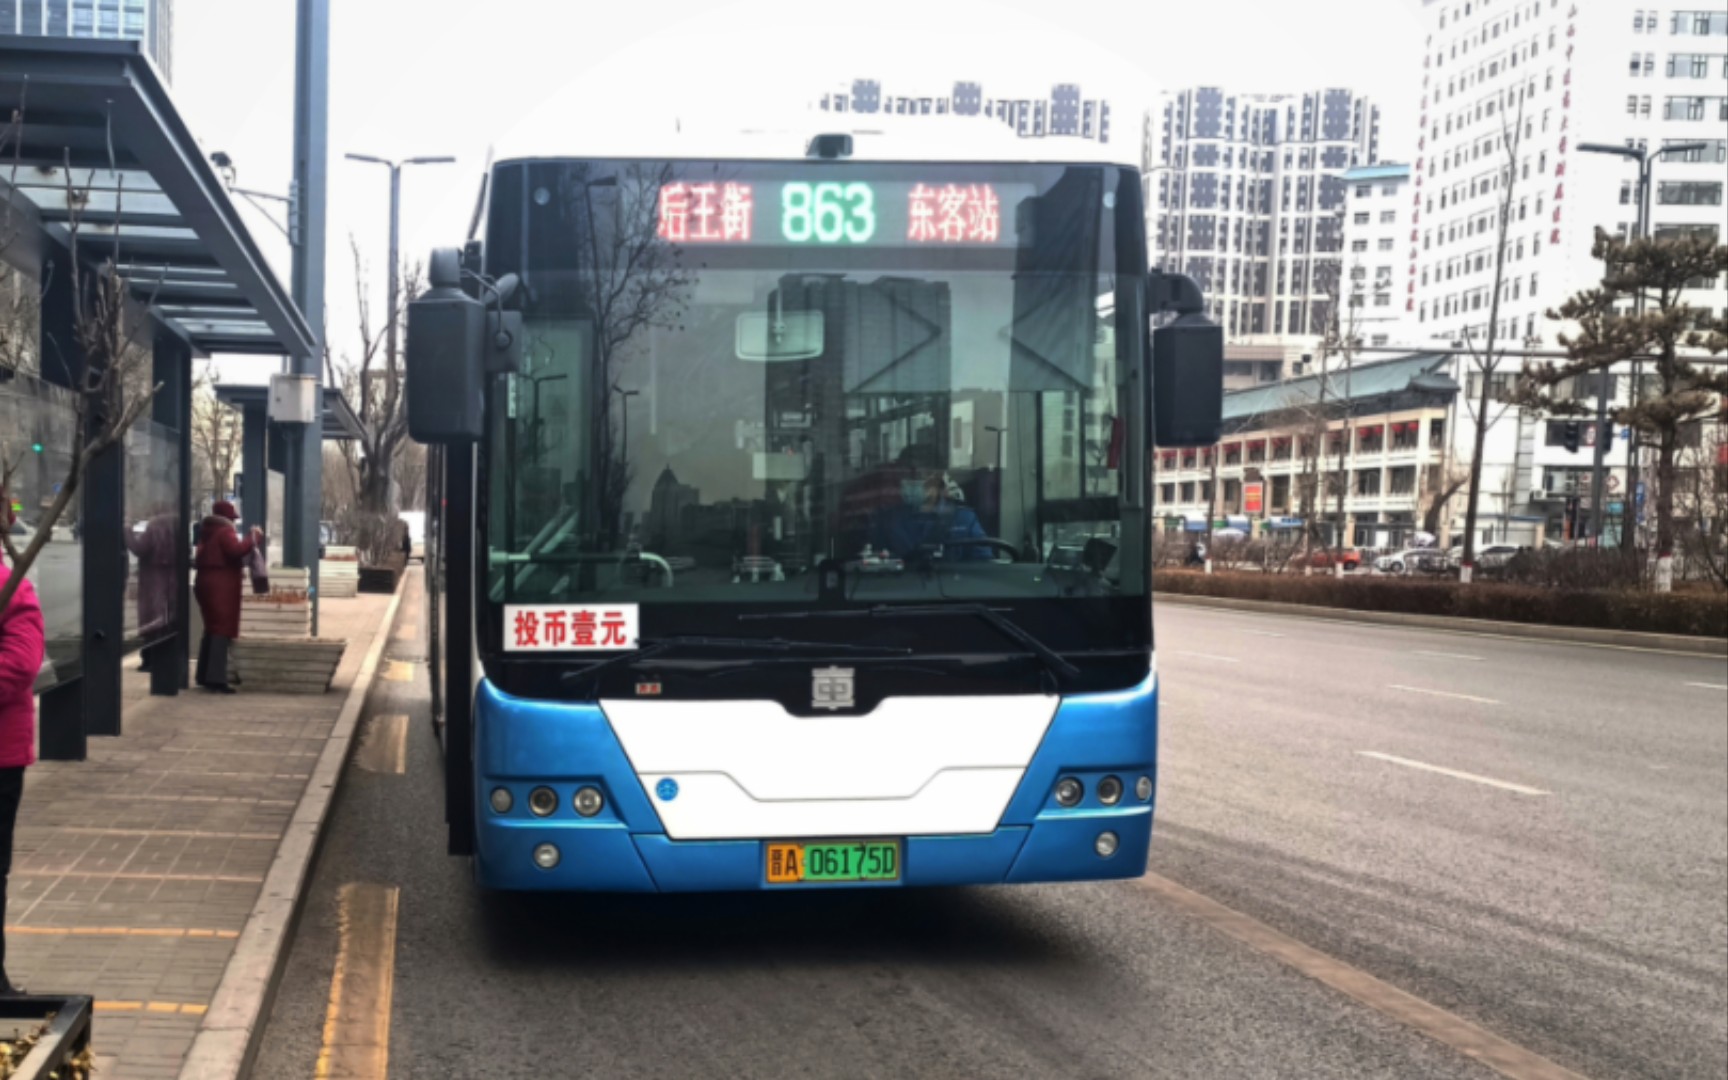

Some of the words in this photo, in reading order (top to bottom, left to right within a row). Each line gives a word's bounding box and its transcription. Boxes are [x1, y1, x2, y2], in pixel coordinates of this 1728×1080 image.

[658, 182, 752, 241] 后王街
[782, 181, 874, 242] 863
[908, 183, 999, 241] 东客站
[514, 610, 627, 647] 投币壹元
